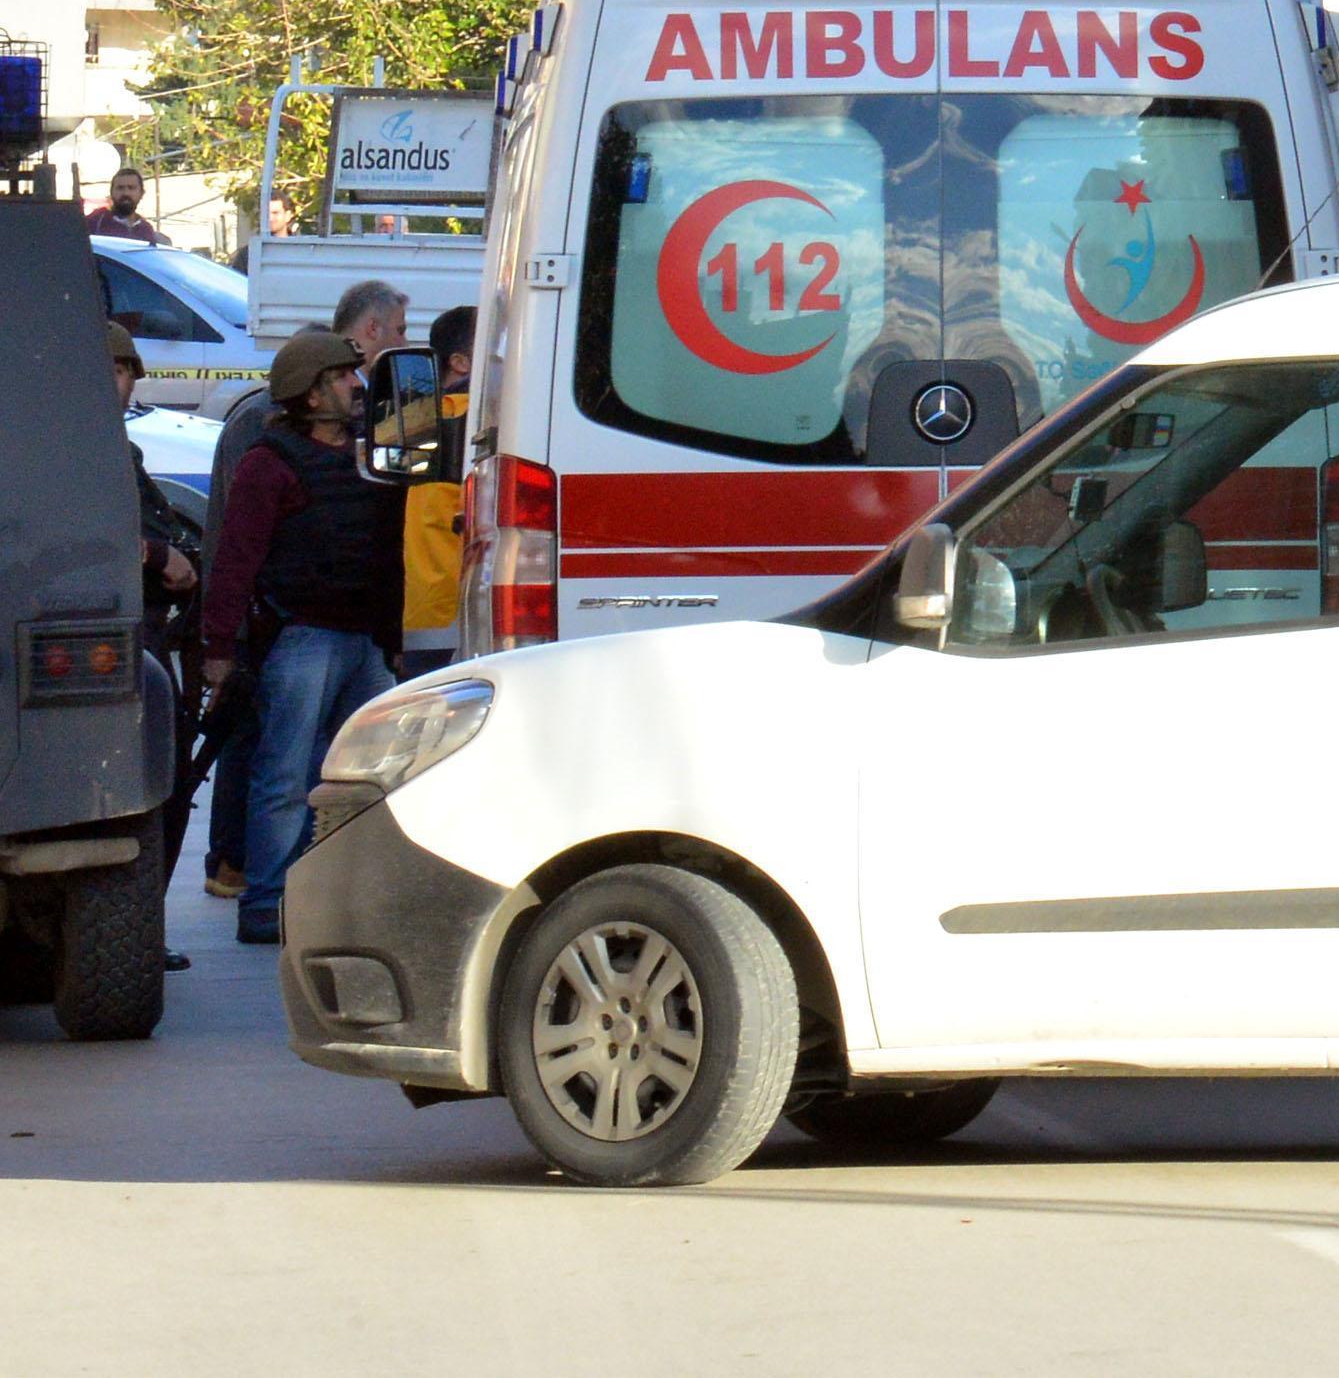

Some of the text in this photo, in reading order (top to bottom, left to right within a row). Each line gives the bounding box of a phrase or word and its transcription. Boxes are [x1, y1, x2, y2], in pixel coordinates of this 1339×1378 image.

[645, 10, 1206, 82] AMBULANS
[340, 140, 450, 171] alsandus
[707, 241, 842, 313] 112
[576, 594, 720, 610] SPRINTER
